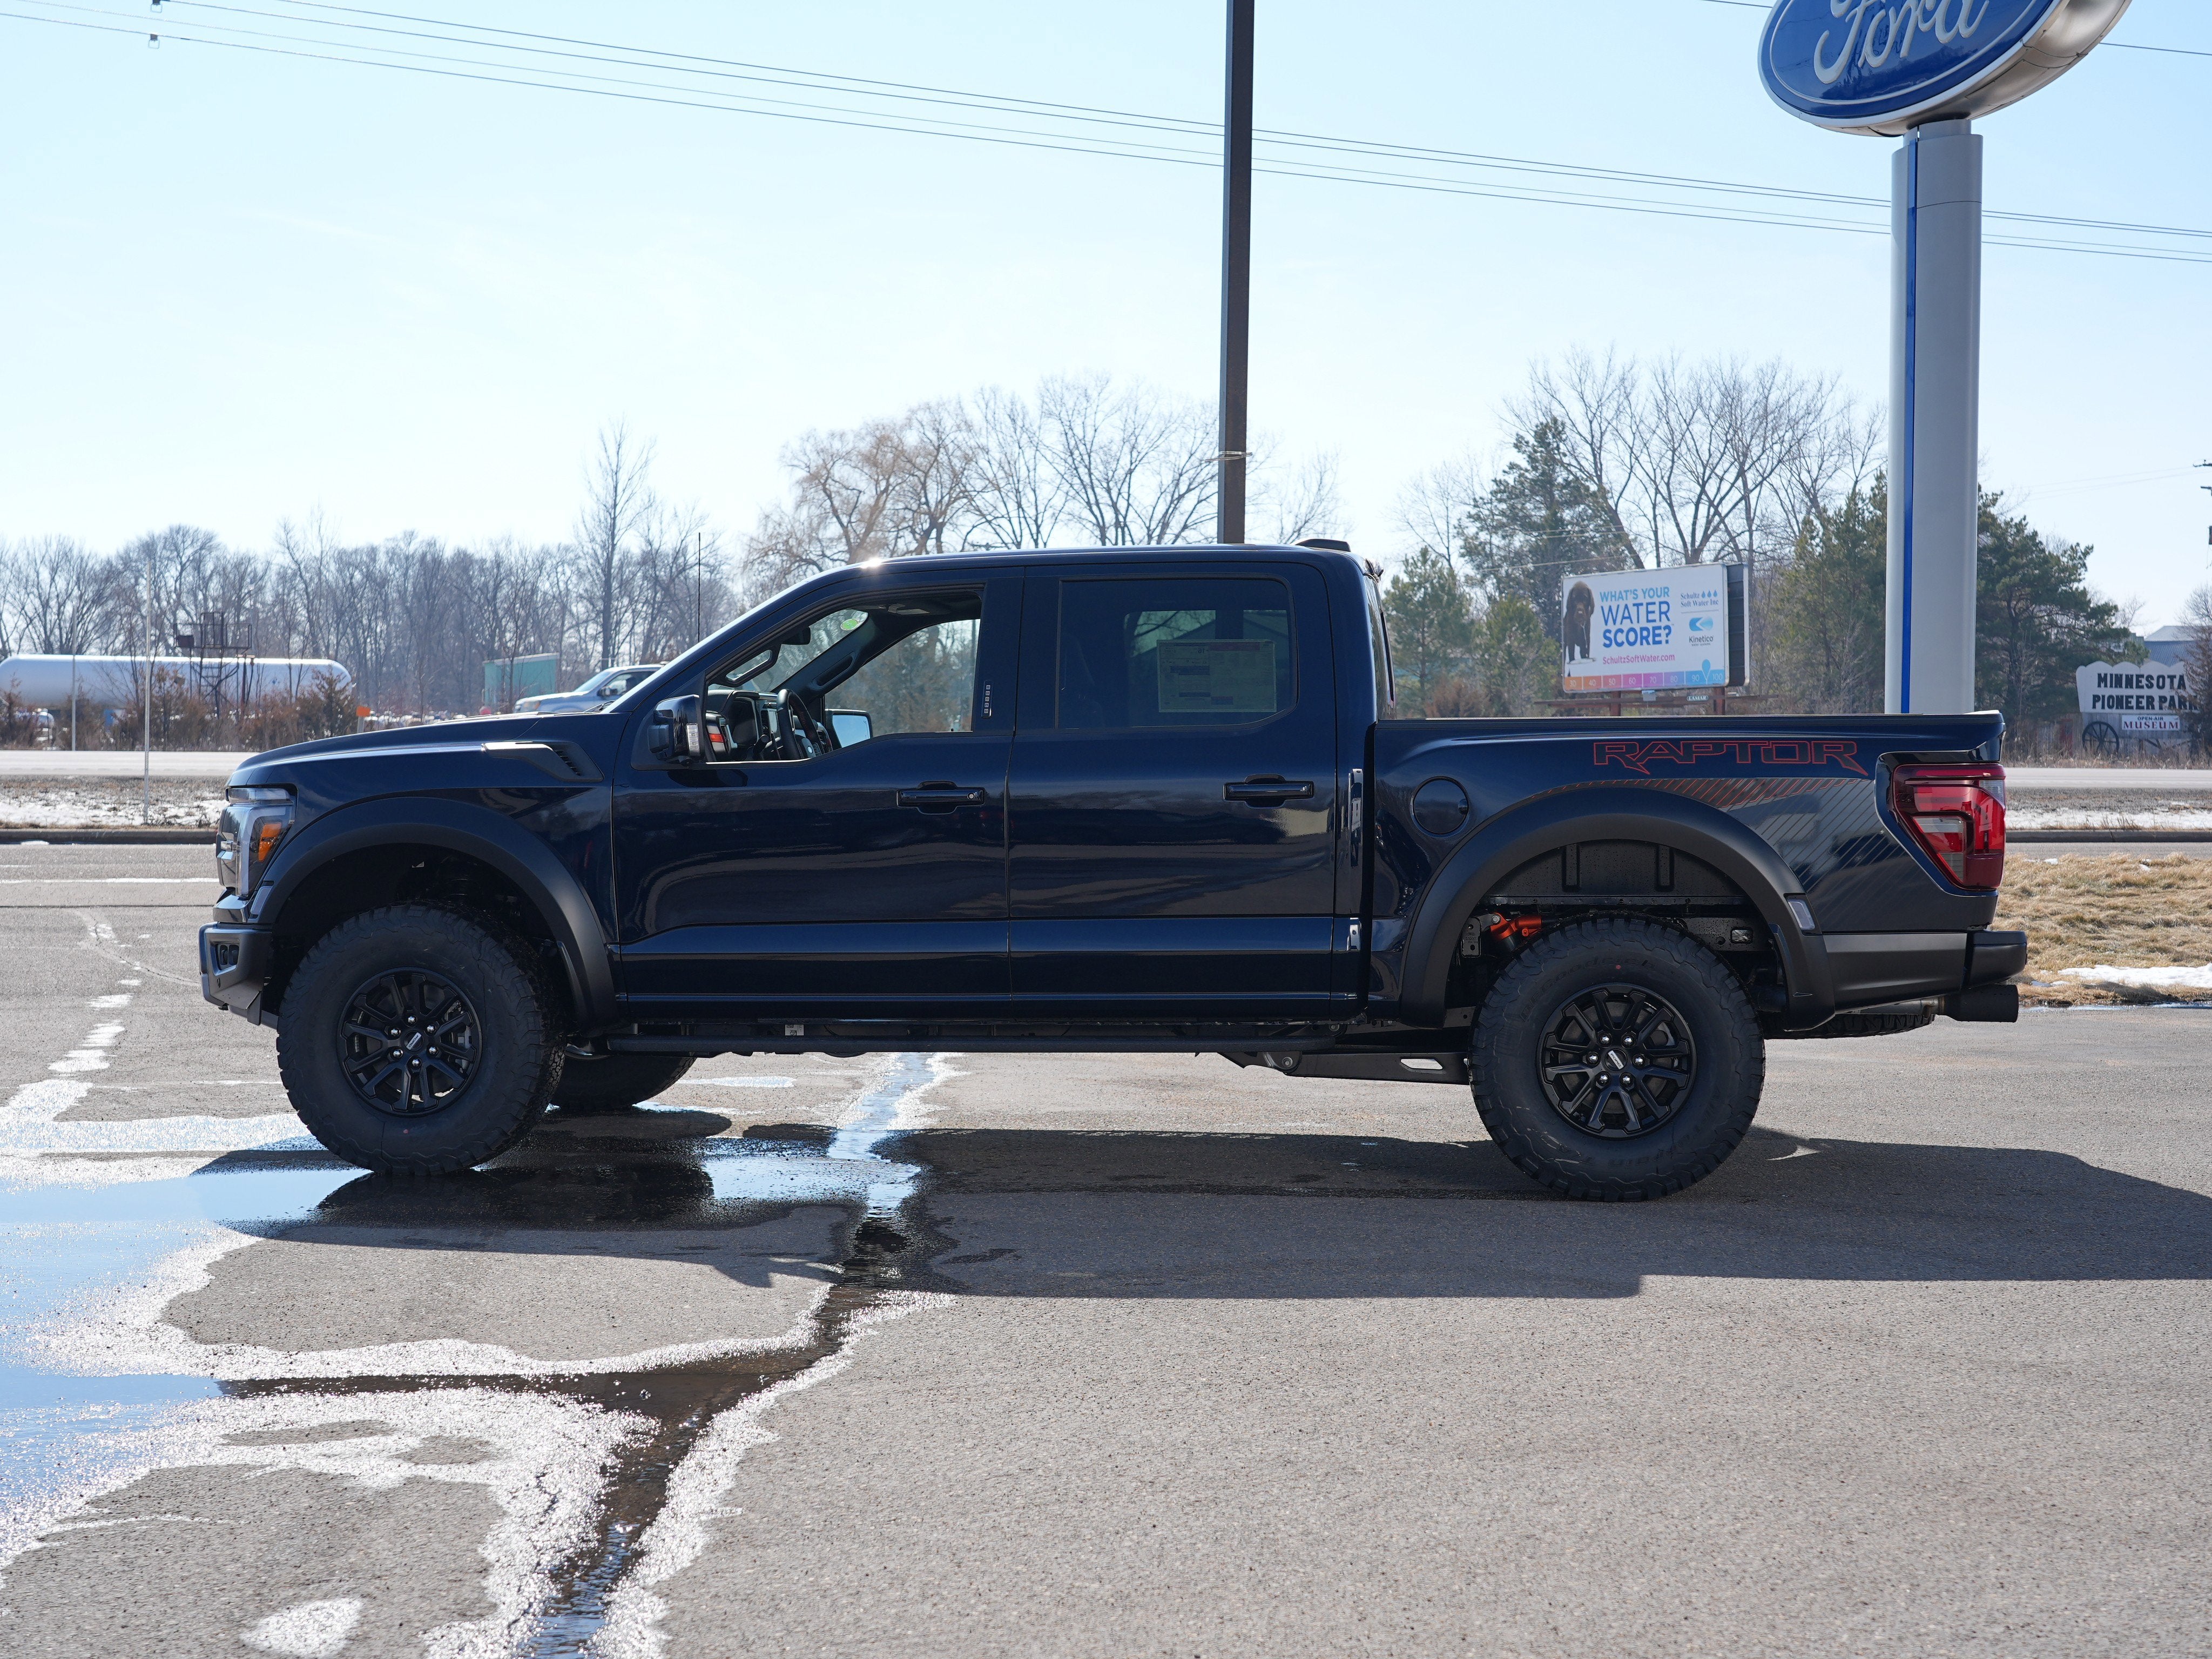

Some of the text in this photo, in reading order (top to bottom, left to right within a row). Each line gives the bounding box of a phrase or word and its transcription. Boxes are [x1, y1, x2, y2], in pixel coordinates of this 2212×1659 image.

[1813, 0, 1990, 84] Ford
[1600, 586, 1670, 602] WHAT'S YOUR
[1601, 601, 1670, 626] WATER
[1603, 625, 1671, 648] SCORE?
[1603, 654, 1675, 665] SchultzSoftWater.com
[1628, 677, 1636, 685] 60
[2098, 673, 2186, 689] MINNESOTA
[2092, 694, 2155, 710] PIONEER
[2123, 721, 2179, 729] MUSEUM
[1594, 741, 1868, 775] RAPTOR
